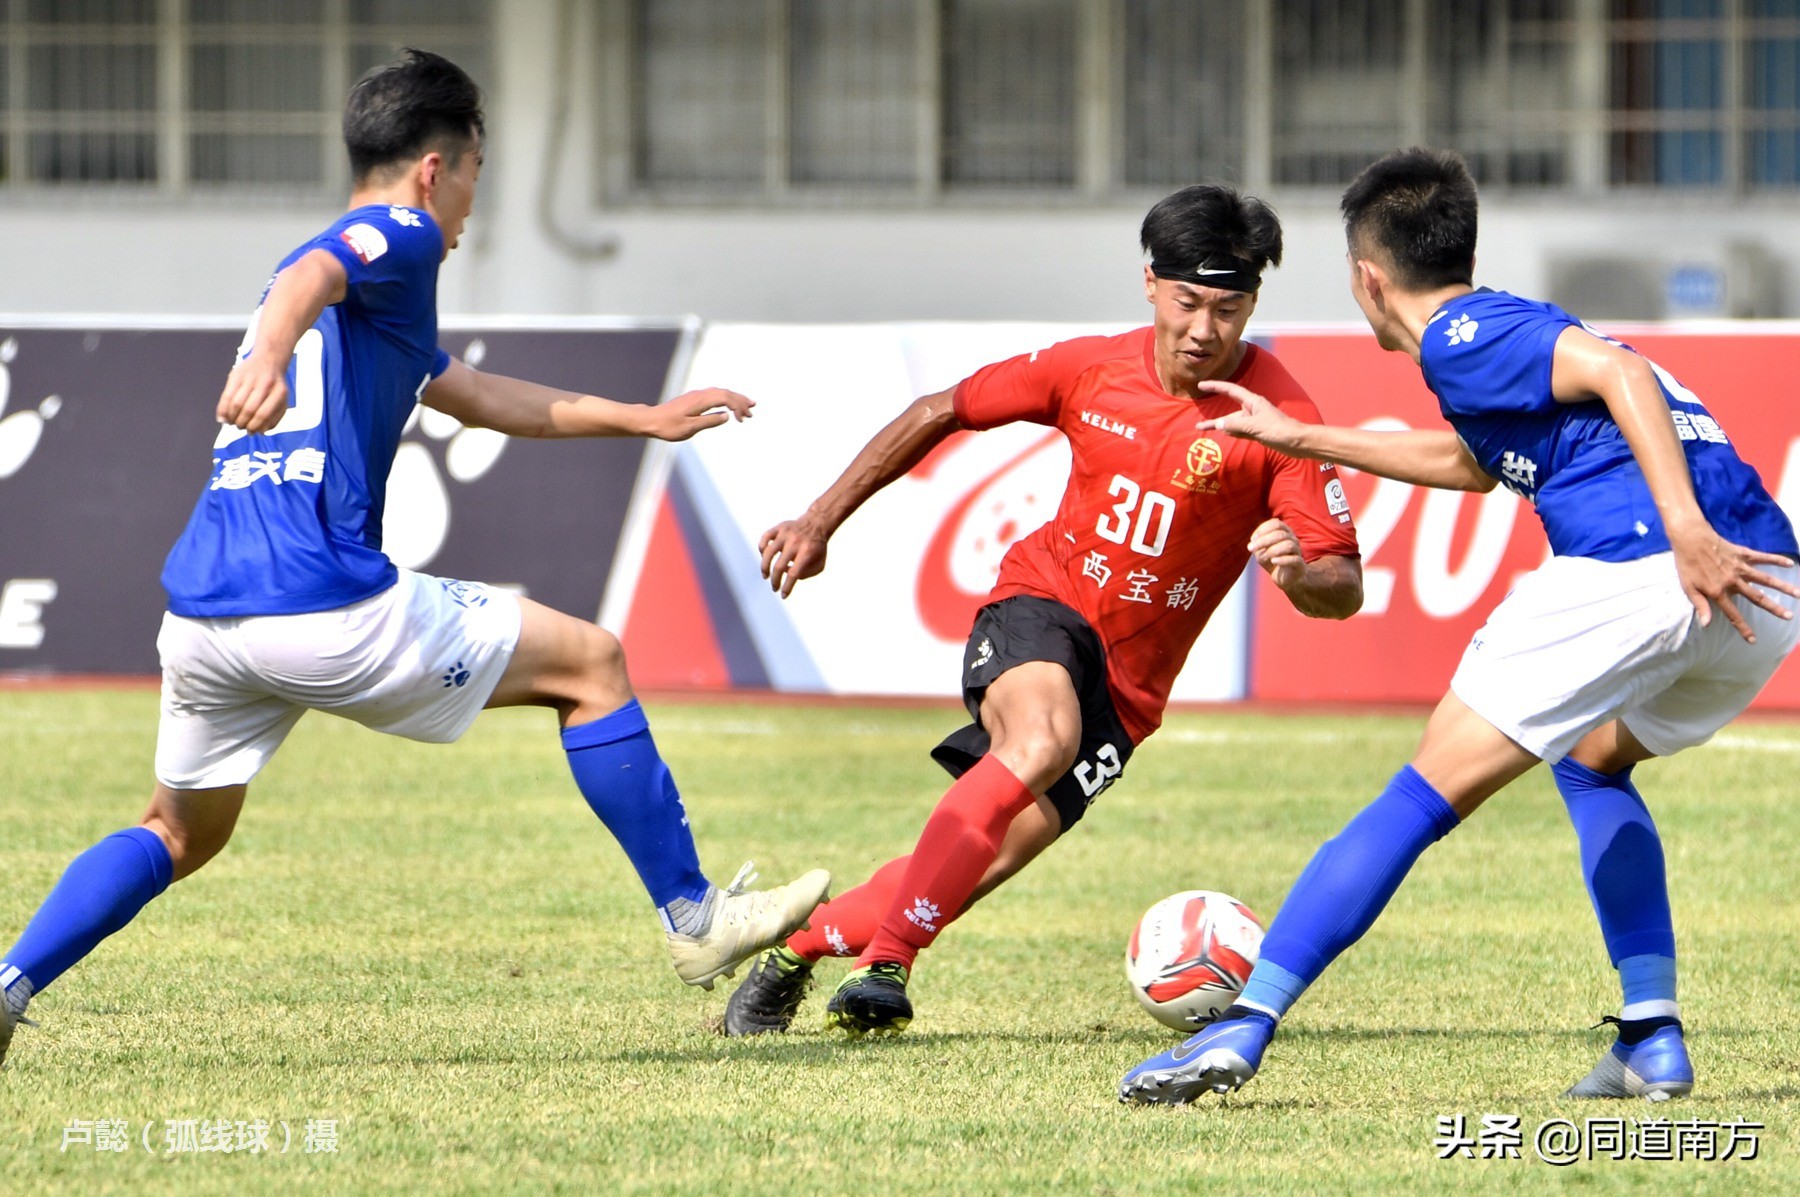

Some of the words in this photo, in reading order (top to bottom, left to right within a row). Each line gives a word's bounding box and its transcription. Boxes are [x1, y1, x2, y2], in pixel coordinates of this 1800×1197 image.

[1081, 410, 1137, 440] KELME
[210, 448, 326, 490] 建天信
[1095, 473, 1176, 557] 30
[1064, 530, 1199, 611] 西宝韵
[1073, 742, 1122, 803] 3
[903, 908, 936, 933] KELME
